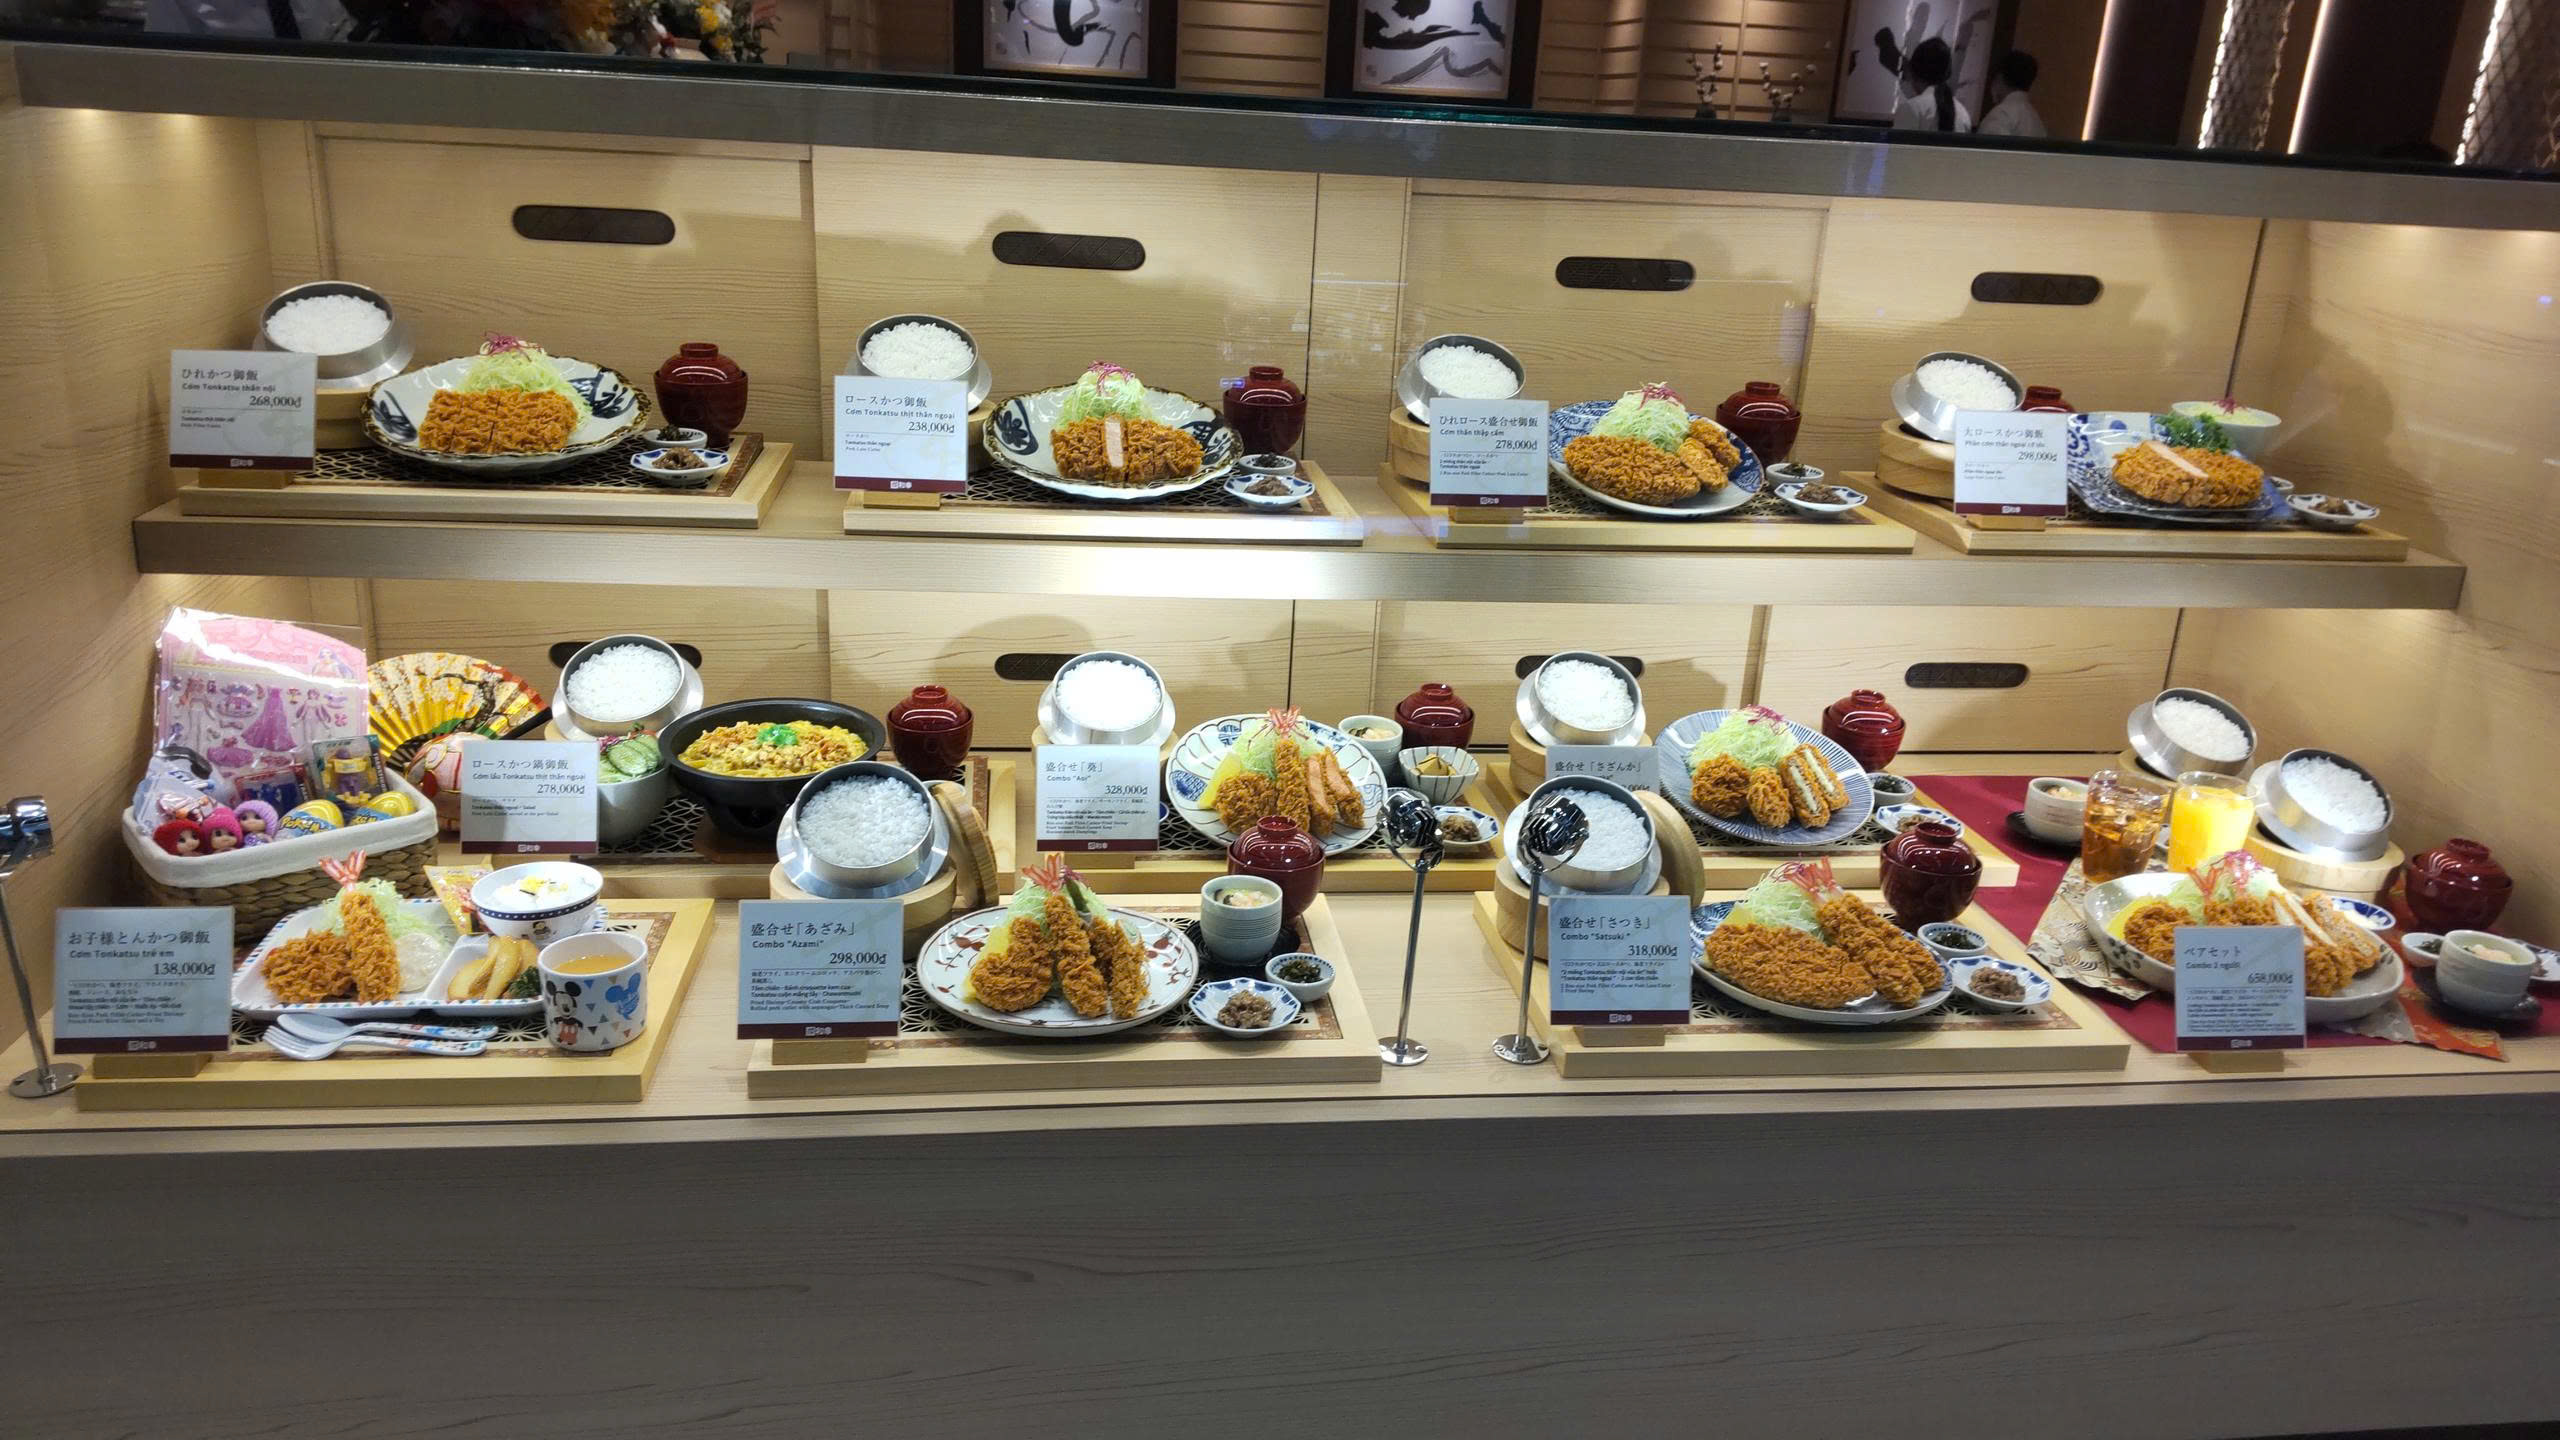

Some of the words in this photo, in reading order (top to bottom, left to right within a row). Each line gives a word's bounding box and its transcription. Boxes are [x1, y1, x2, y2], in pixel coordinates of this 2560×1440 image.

[182, 369, 259, 381] ひれかつ御飯
[203, 383, 239, 391] Tonkatsu
[845, 395, 928, 408] ロースかつ御飯
[1440, 416, 1538, 427] ひれロース盛合せ御飯
[472, 760, 569, 770] ロースかつ鍋御飯
[1560, 916, 1651, 929] 盛合せ「さつき」
[751, 921, 856, 937] 盛合せ「あざみ」
[67, 930, 211, 946] お子様とんかつ御飯
[752, 940, 784, 948] Combo
[787, 940, 824, 948] "Azami"
[95, 950, 140, 958] Tonkatsu
[2184, 946, 2241, 958] ペアセット
